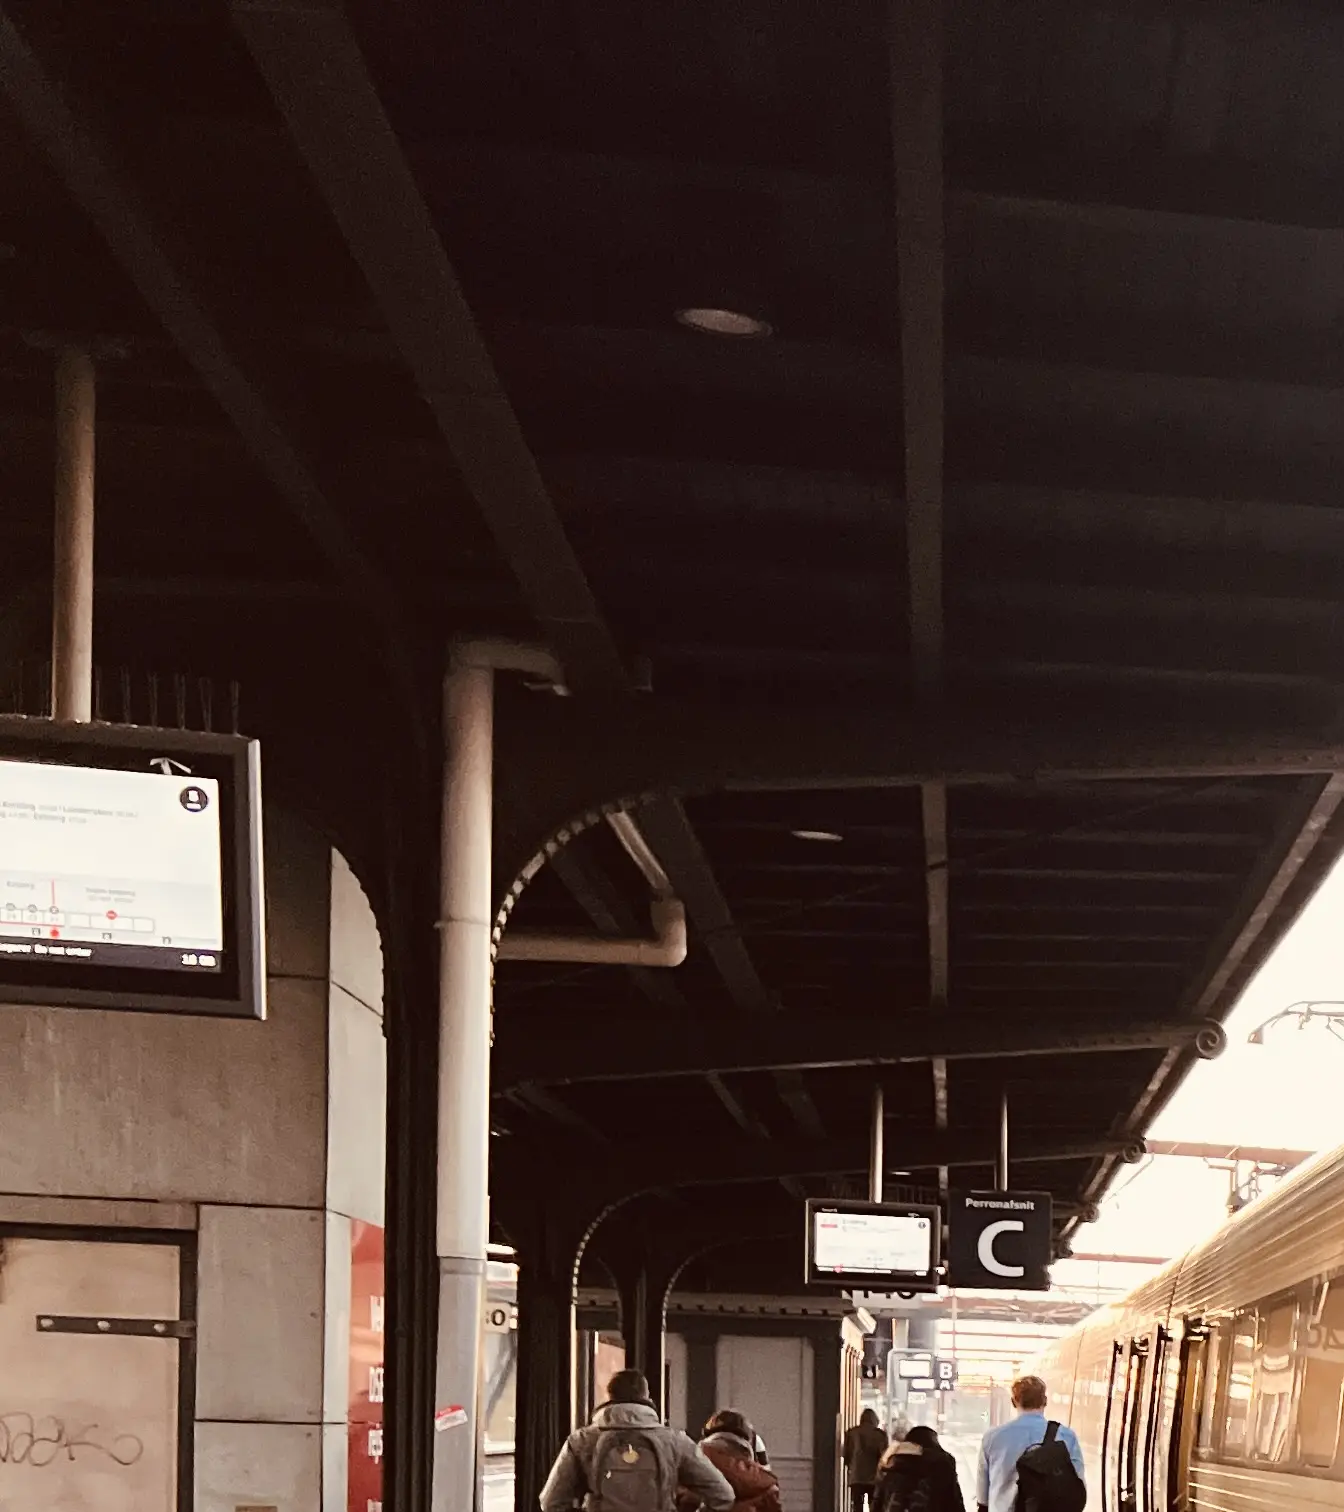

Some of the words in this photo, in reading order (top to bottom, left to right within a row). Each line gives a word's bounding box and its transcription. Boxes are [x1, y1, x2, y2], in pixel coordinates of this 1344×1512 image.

[965, 1198, 1035, 1211] Perronafsnit
[977, 1220, 1024, 1277] C
[939, 1362, 952, 1379] B
